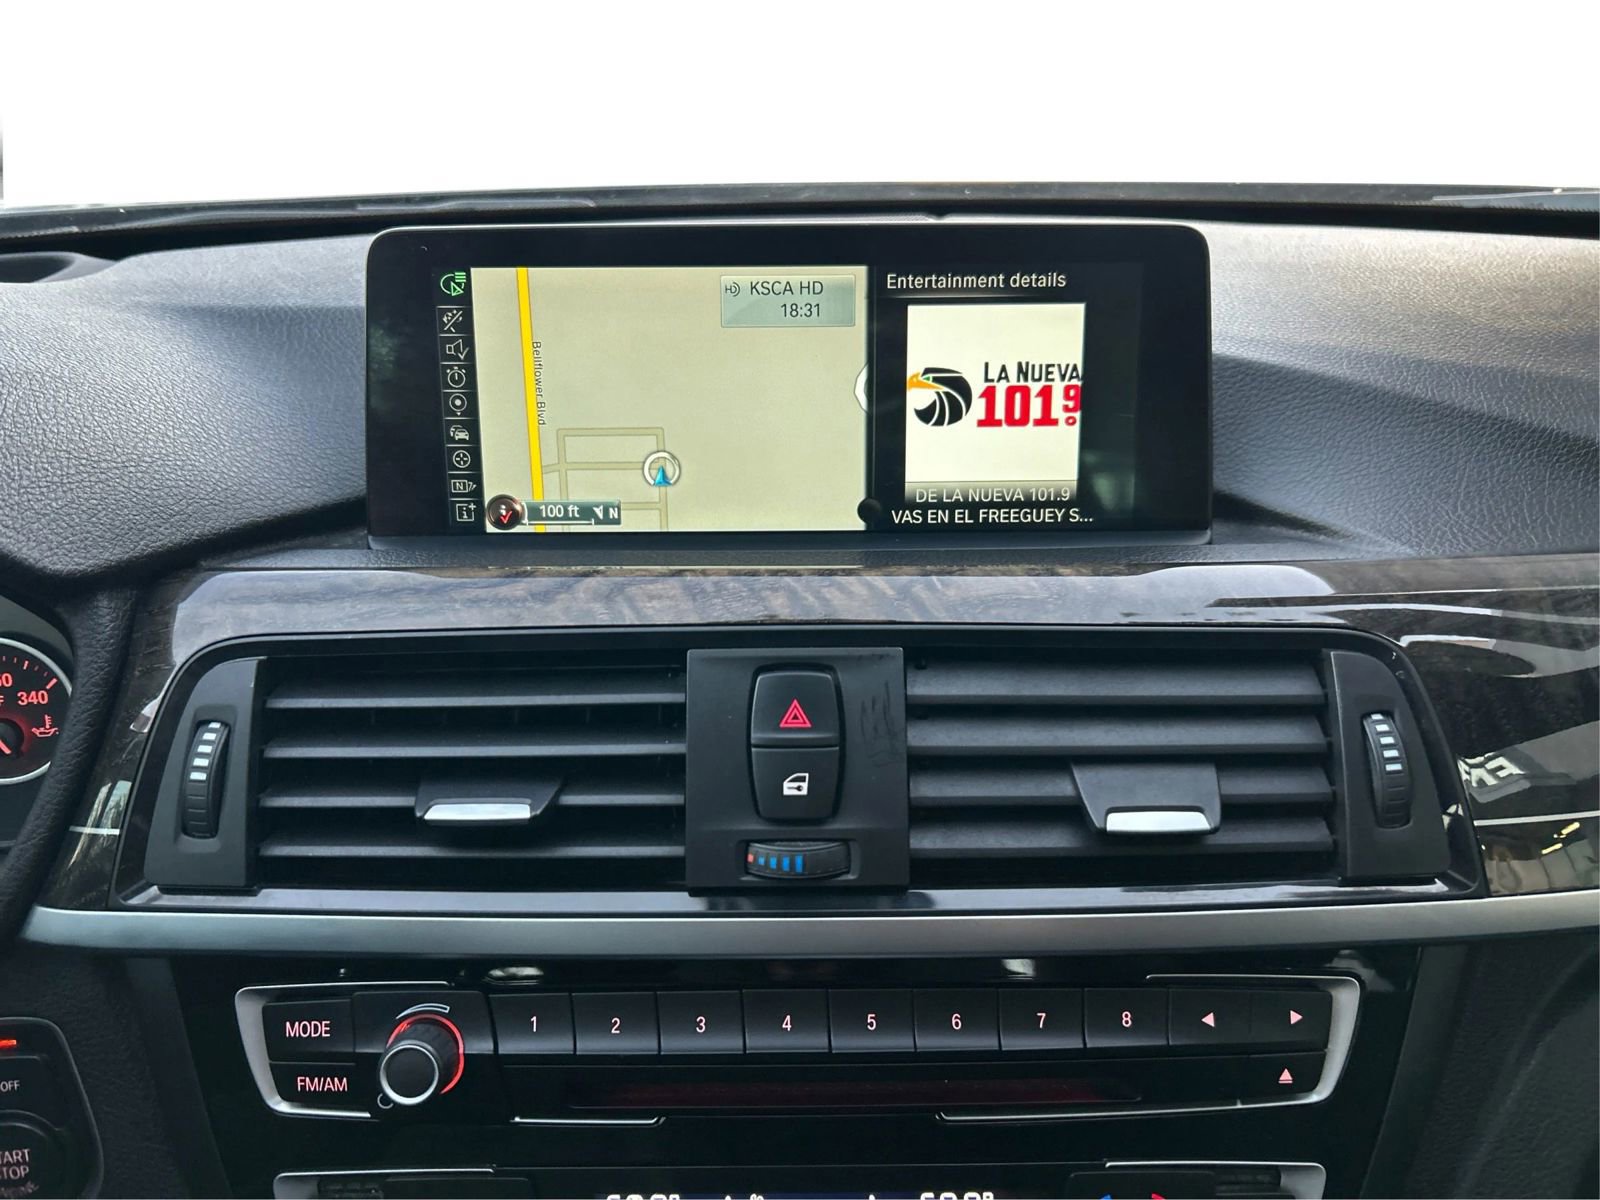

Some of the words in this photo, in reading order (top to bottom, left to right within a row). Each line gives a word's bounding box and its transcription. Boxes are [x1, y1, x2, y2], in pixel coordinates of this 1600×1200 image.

[749, 280, 795, 296] KSCA
[798, 280, 824, 296] HD
[886, 273, 1005, 290] Entertainment
[1009, 271, 1067, 288] details
[780, 302, 821, 318] 18:31
[531, 341, 544, 399] Bellflower
[983, 361, 1010, 384] LA
[536, 400, 547, 426] Blvd
[915, 488, 938, 503] DE
[942, 488, 964, 503] LA
[968, 486, 1025, 502] NUEVA
[1029, 486, 1071, 502] 101.9
[538, 505, 565, 519] 100
[566, 504, 580, 519] ft
[609, 507, 619, 519] N
[890, 508, 923, 525] VAS
[927, 508, 950, 524] EN
[954, 508, 975, 524] EL
[978, 507, 1066, 524] FREEGUEY
[17, 690, 49, 706] 340
[530, 1015, 537, 1033] 1
[611, 1017, 621, 1034] 2
[695, 1016, 706, 1033] 3
[782, 1014, 792, 1032] 4
[867, 1013, 877, 1031] 5
[951, 1013, 962, 1030] 6
[1036, 1012, 1046, 1029] 7
[1121, 1011, 1132, 1028] 8
[285, 1020, 331, 1038] MODE
[0, 1079, 21, 1092] OFF
[297, 1076, 348, 1093] FM/AM
